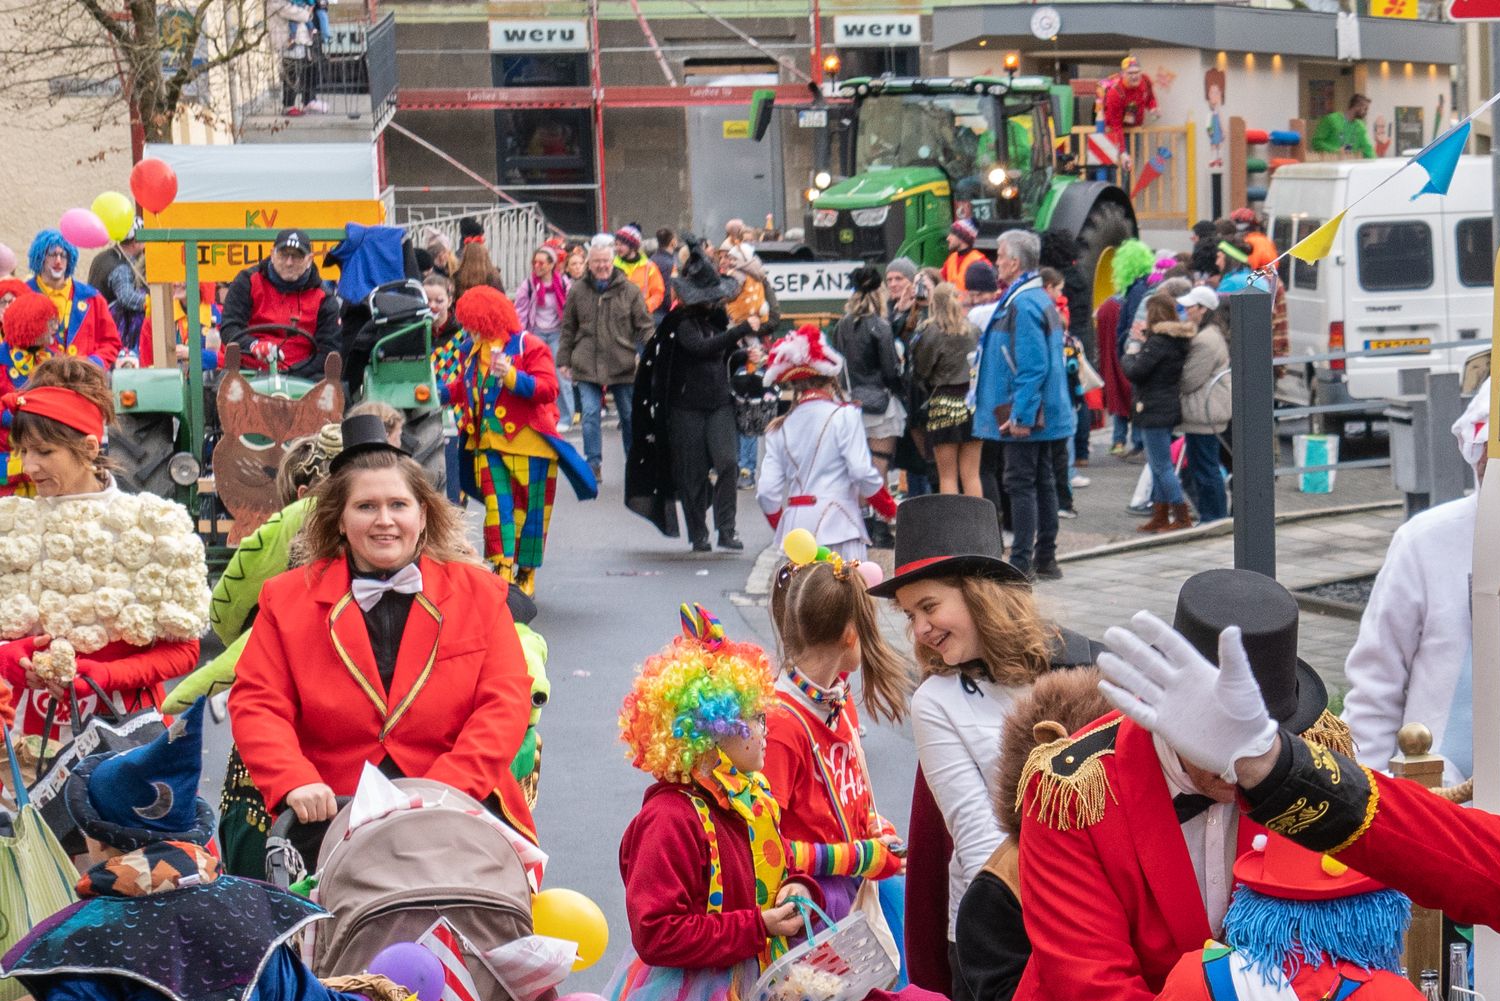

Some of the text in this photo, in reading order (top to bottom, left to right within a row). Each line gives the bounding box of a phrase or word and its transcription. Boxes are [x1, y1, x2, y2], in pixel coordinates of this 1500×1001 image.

[503, 28, 576, 43] weru
[843, 22, 913, 37] weru
[245, 208, 278, 229] KV
[765, 268, 853, 293] SEPÄNZ
